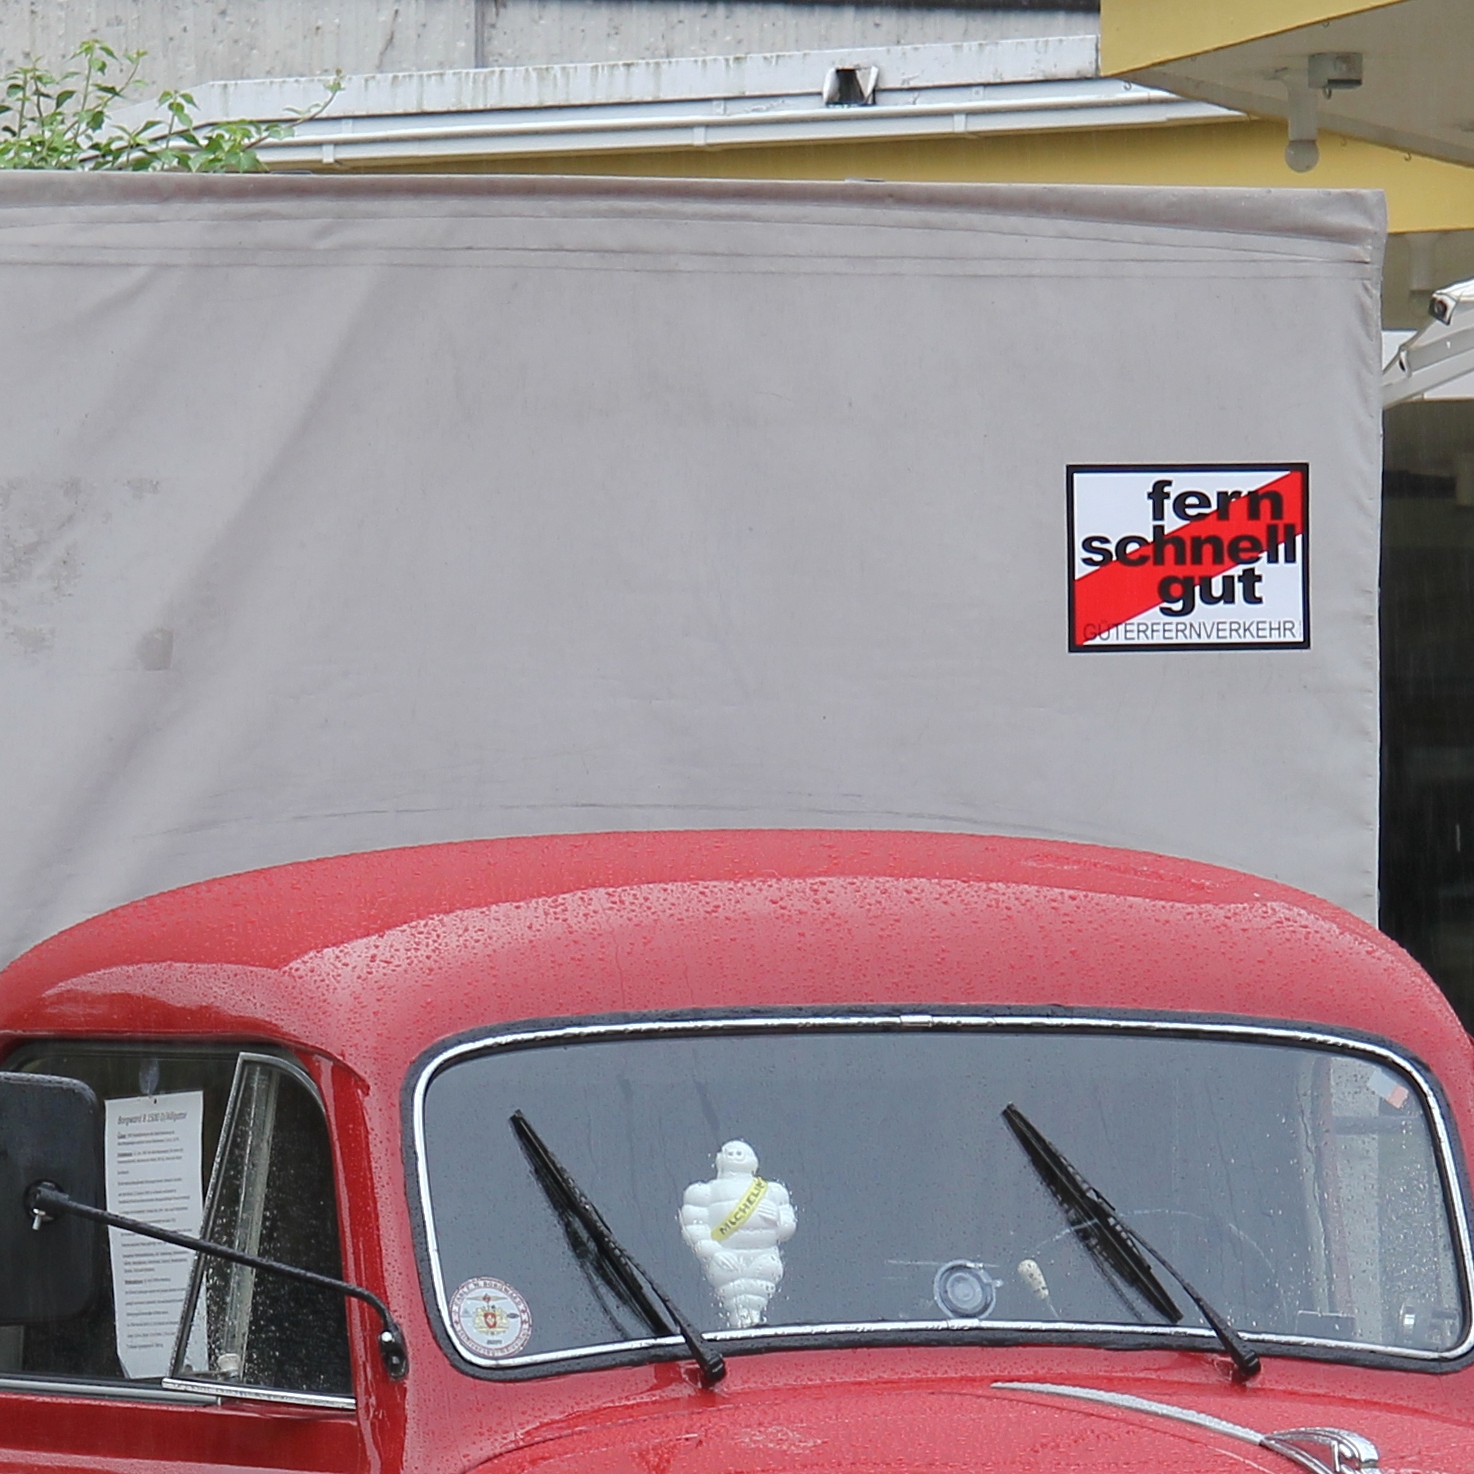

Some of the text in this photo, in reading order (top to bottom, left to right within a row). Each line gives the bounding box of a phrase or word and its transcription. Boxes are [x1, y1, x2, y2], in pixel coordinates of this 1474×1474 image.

[1147, 479, 1284, 522] fern
[1080, 523, 1297, 568] schnell
[1157, 566, 1264, 618] gut
[1083, 619, 1296, 642] GÜTERFERNVERKEHR
[719, 1174, 767, 1236] MICHELIN
